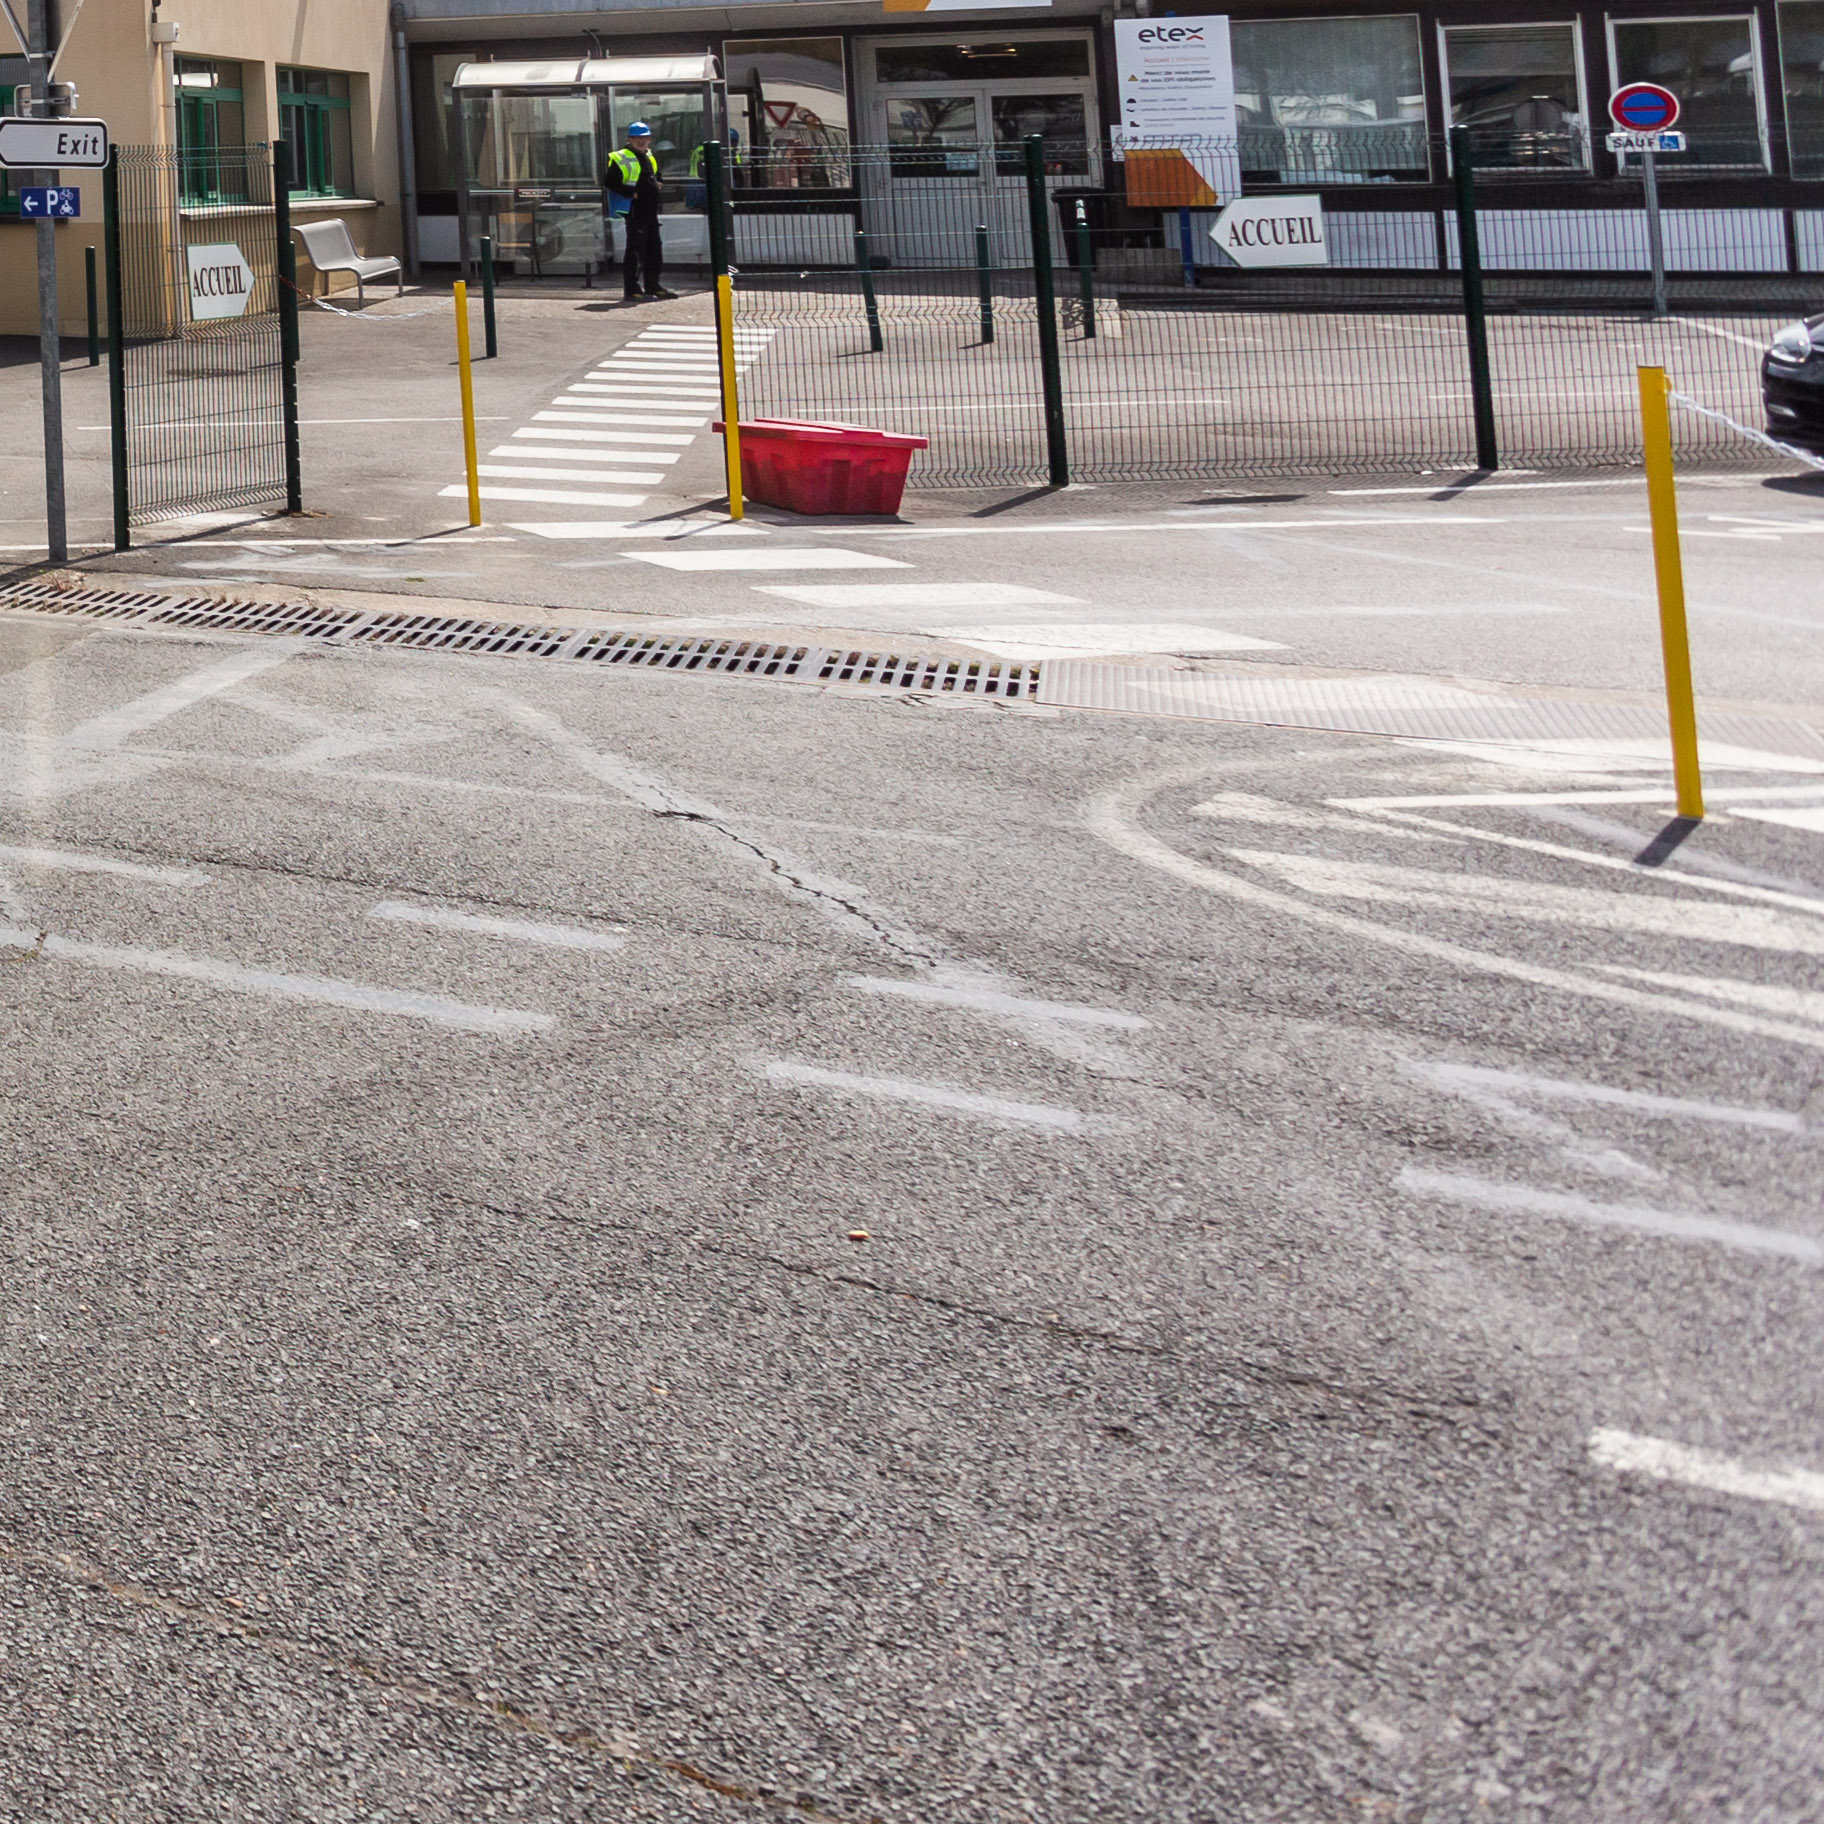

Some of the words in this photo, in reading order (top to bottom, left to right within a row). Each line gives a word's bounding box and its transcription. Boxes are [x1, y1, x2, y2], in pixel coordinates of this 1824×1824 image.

[1138, 26, 1204, 43] etex
[57, 133, 99, 155] Exit
[1612, 137, 1655, 148] SAUF
[1228, 217, 1322, 247] ACCUEIL
[193, 265, 247, 297] ACCUEIL
